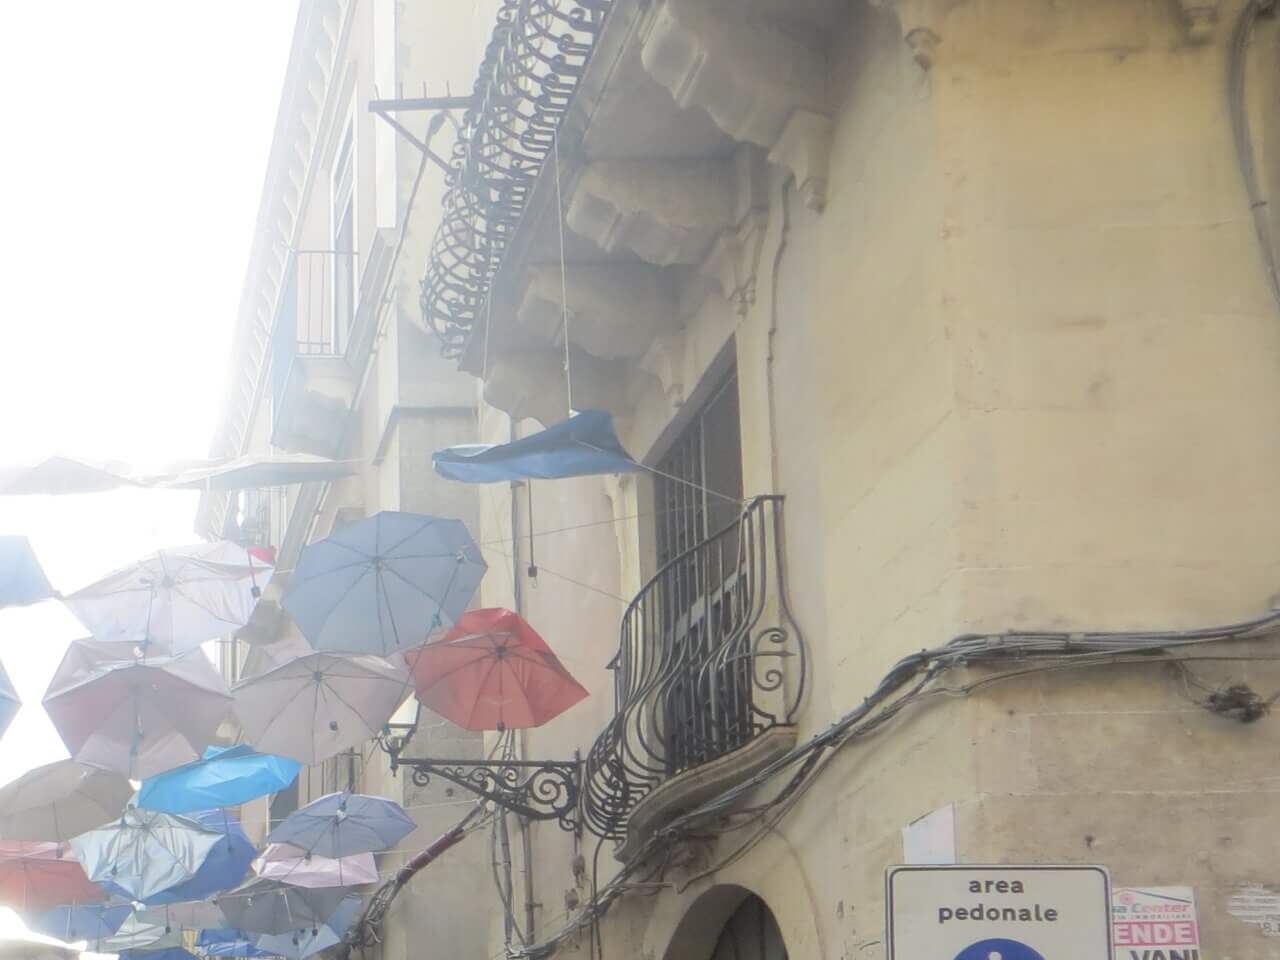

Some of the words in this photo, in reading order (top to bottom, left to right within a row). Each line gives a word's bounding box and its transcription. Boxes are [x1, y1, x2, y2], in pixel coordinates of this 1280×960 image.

[968, 879, 1024, 894] area
[938, 903, 1058, 924] pedonale
[1113, 922, 1193, 944] ENDE
